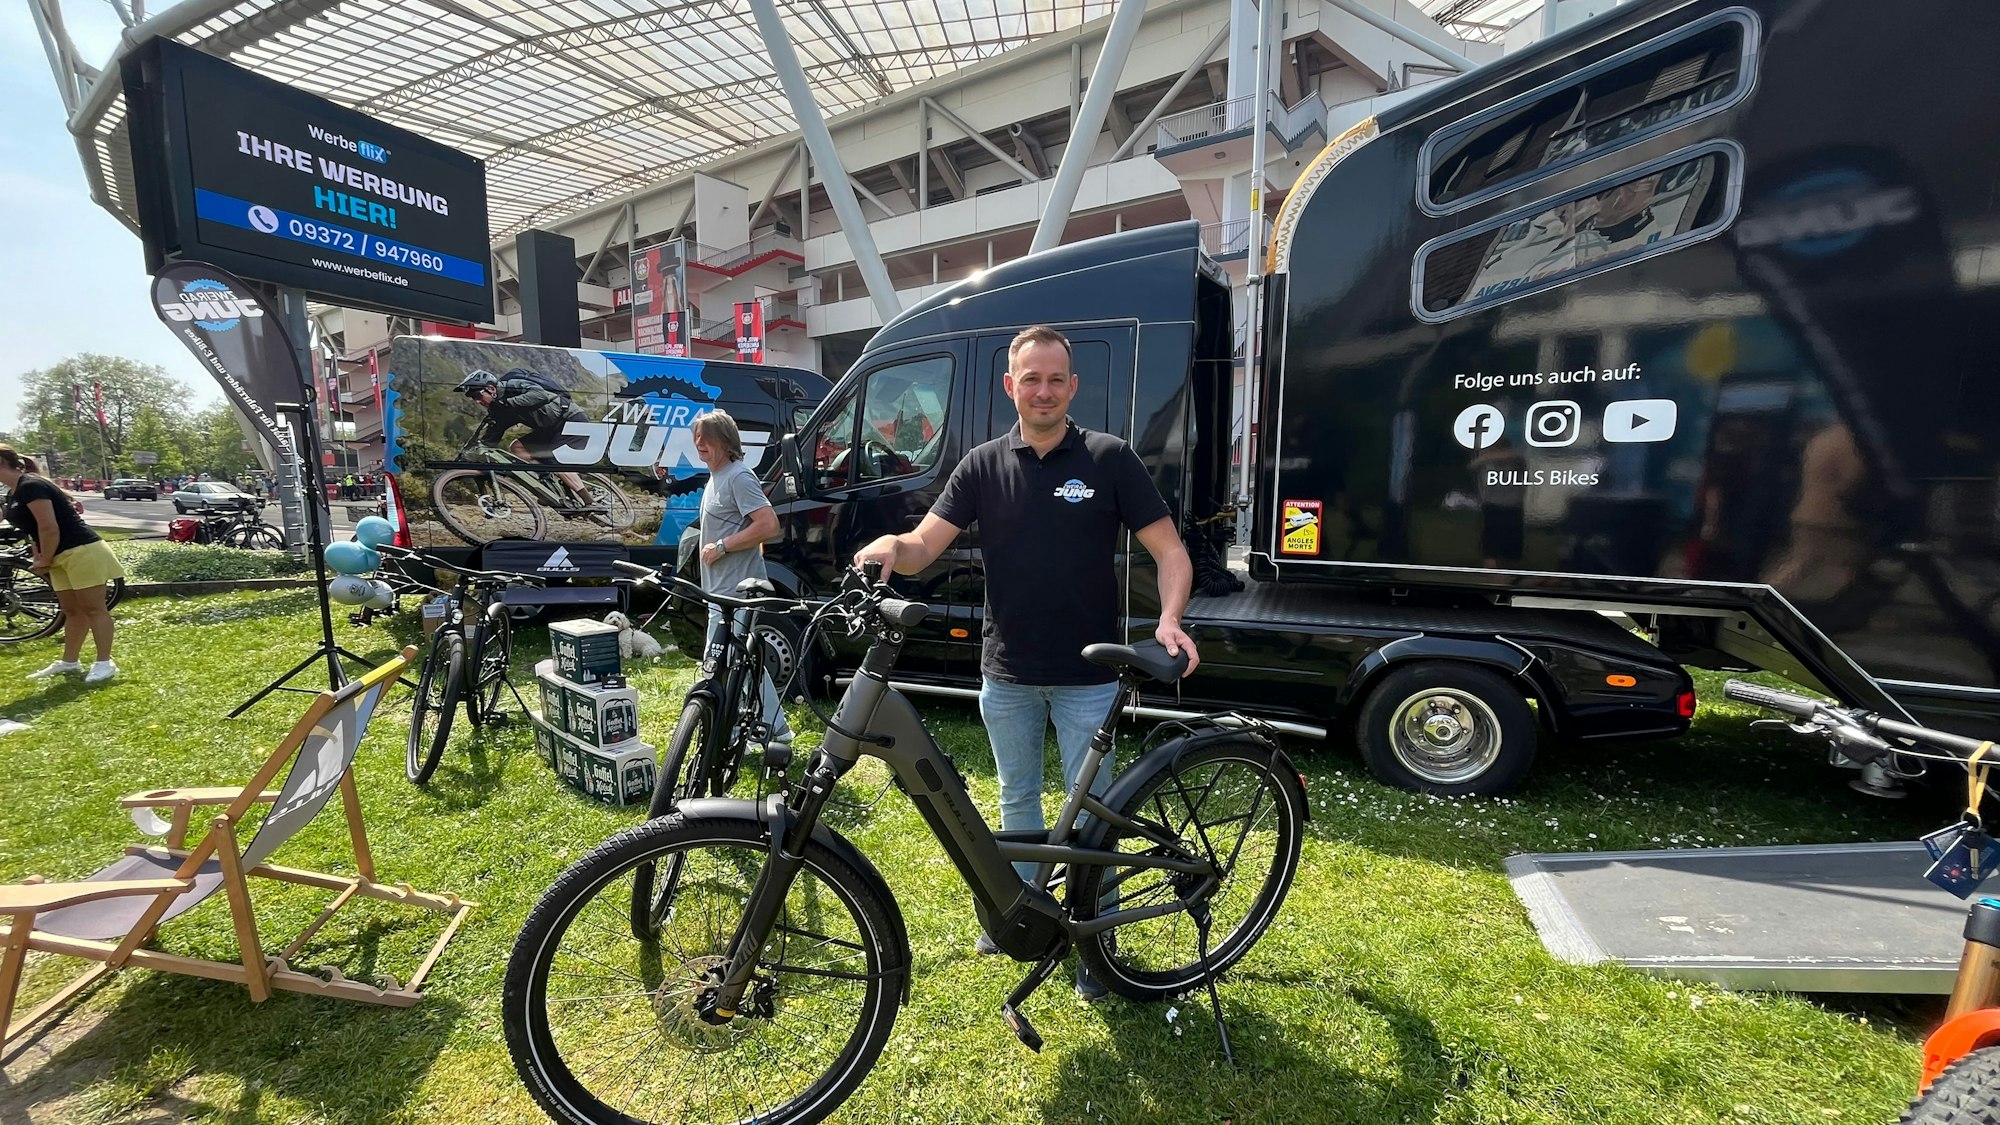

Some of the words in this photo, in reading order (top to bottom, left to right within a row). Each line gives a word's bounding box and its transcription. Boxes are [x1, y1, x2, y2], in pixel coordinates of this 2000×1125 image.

[237, 130, 314, 174] IHRE
[318, 157, 450, 216] WERBUNG
[314, 185, 397, 229] HIER!
[289, 219, 355, 250] 09372
[375, 241, 443, 272] 947960
[312, 257, 409, 287] www.werbeflix.de
[1454, 372, 1504, 391] Folge
[1509, 372, 1543, 386] uns
[1548, 366, 1596, 384] auch
[1601, 363, 1641, 382] auf:
[602, 401, 716, 427] ZWEIRA
[1053, 487, 1095, 498] JUNG
[1487, 470, 1544, 486] BULLS
[1550, 470, 1599, 486] Bikes
